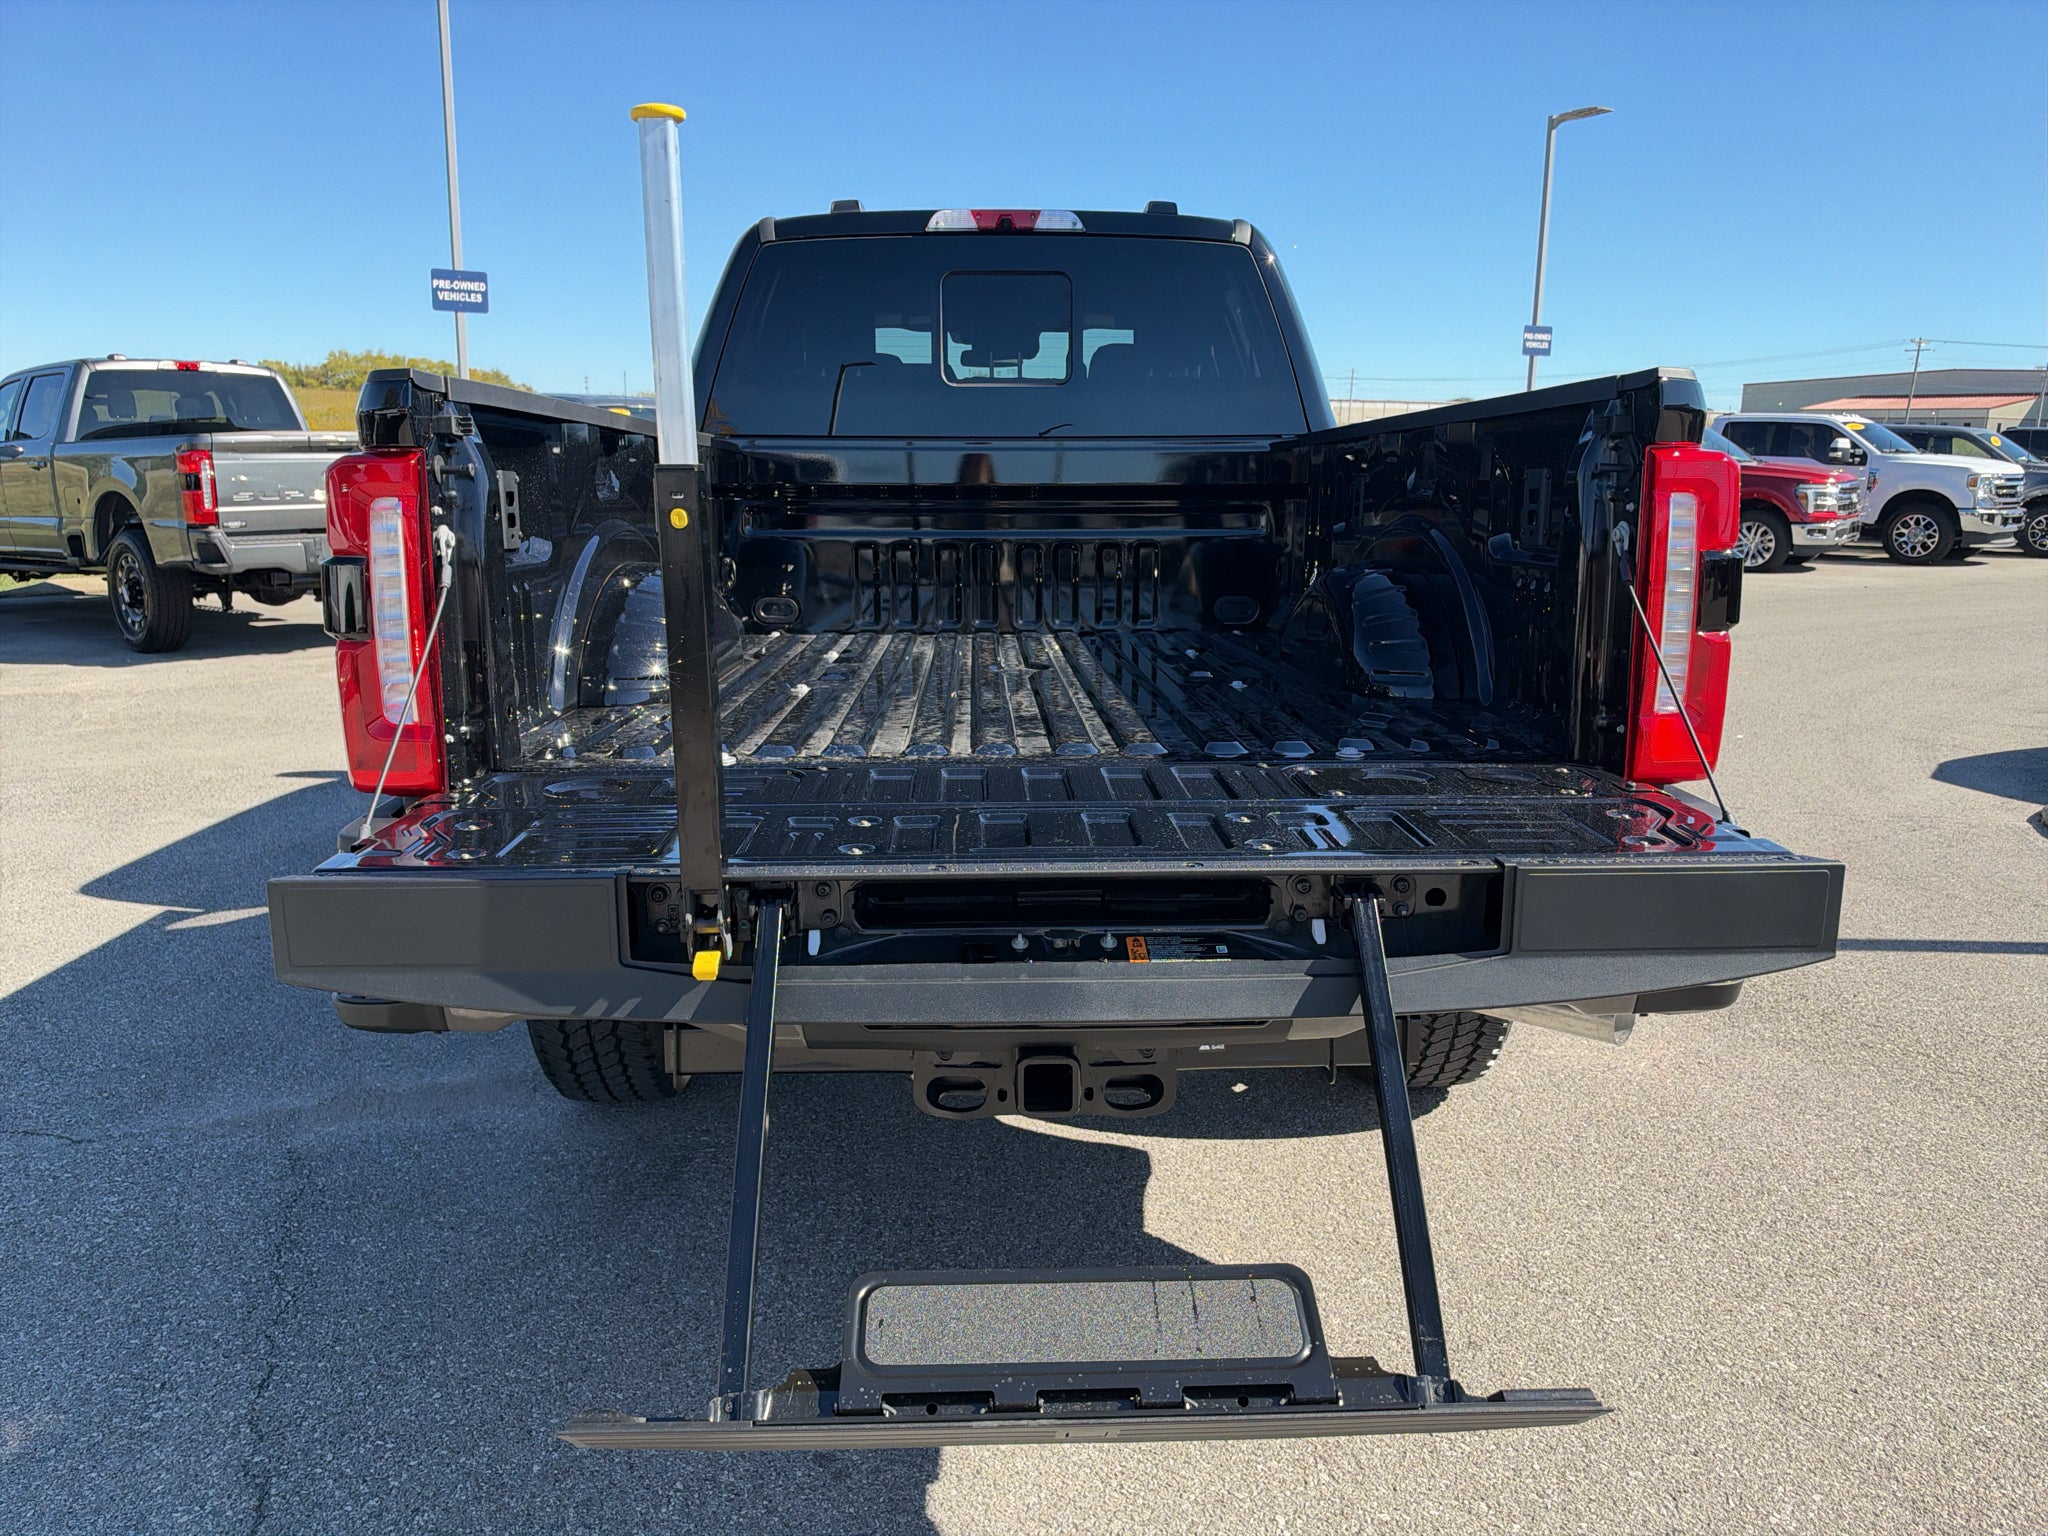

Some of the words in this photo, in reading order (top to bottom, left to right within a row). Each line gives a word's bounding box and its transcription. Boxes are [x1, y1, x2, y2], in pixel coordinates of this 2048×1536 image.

[433, 279, 486, 292] PRE-OWNED
[437, 291, 483, 303] VEHICLES
[1524, 332, 1552, 341] PRE-OWNED
[1525, 341, 1549, 349] VEHICLES
